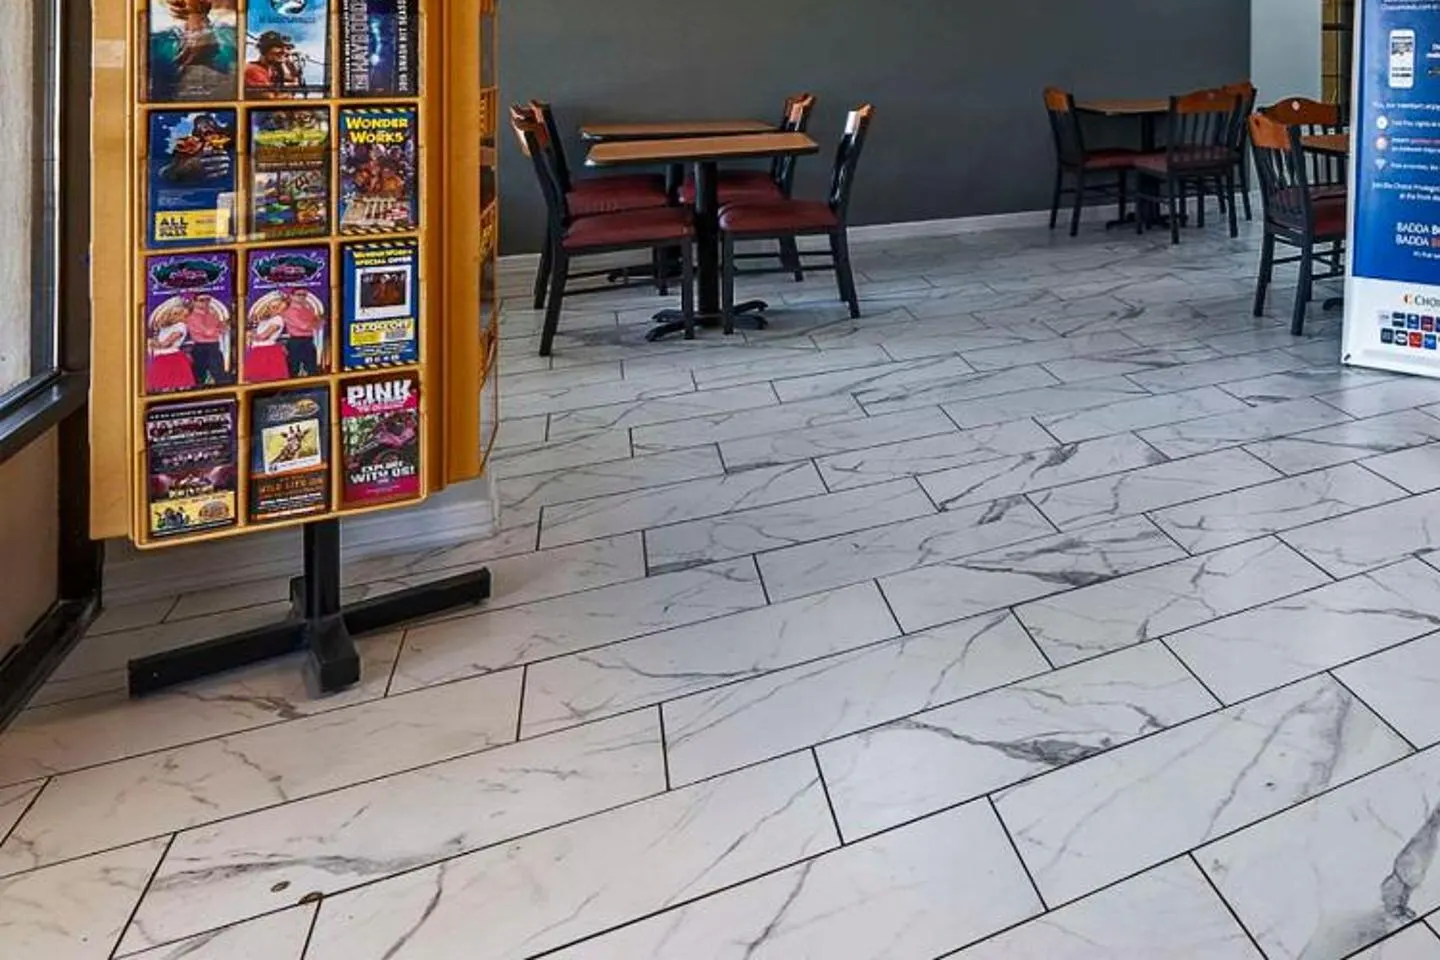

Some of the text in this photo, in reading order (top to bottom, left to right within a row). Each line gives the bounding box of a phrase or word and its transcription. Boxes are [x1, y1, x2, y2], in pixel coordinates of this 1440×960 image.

[345, 116, 409, 129] WONDER
[349, 130, 404, 144] WORKS
[161, 216, 189, 225] ALL
[1397, 222, 1429, 233] BADDA
[1395, 234, 1429, 247] BADDA
[346, 379, 412, 406] PINK
[350, 469, 389, 484] WITH
